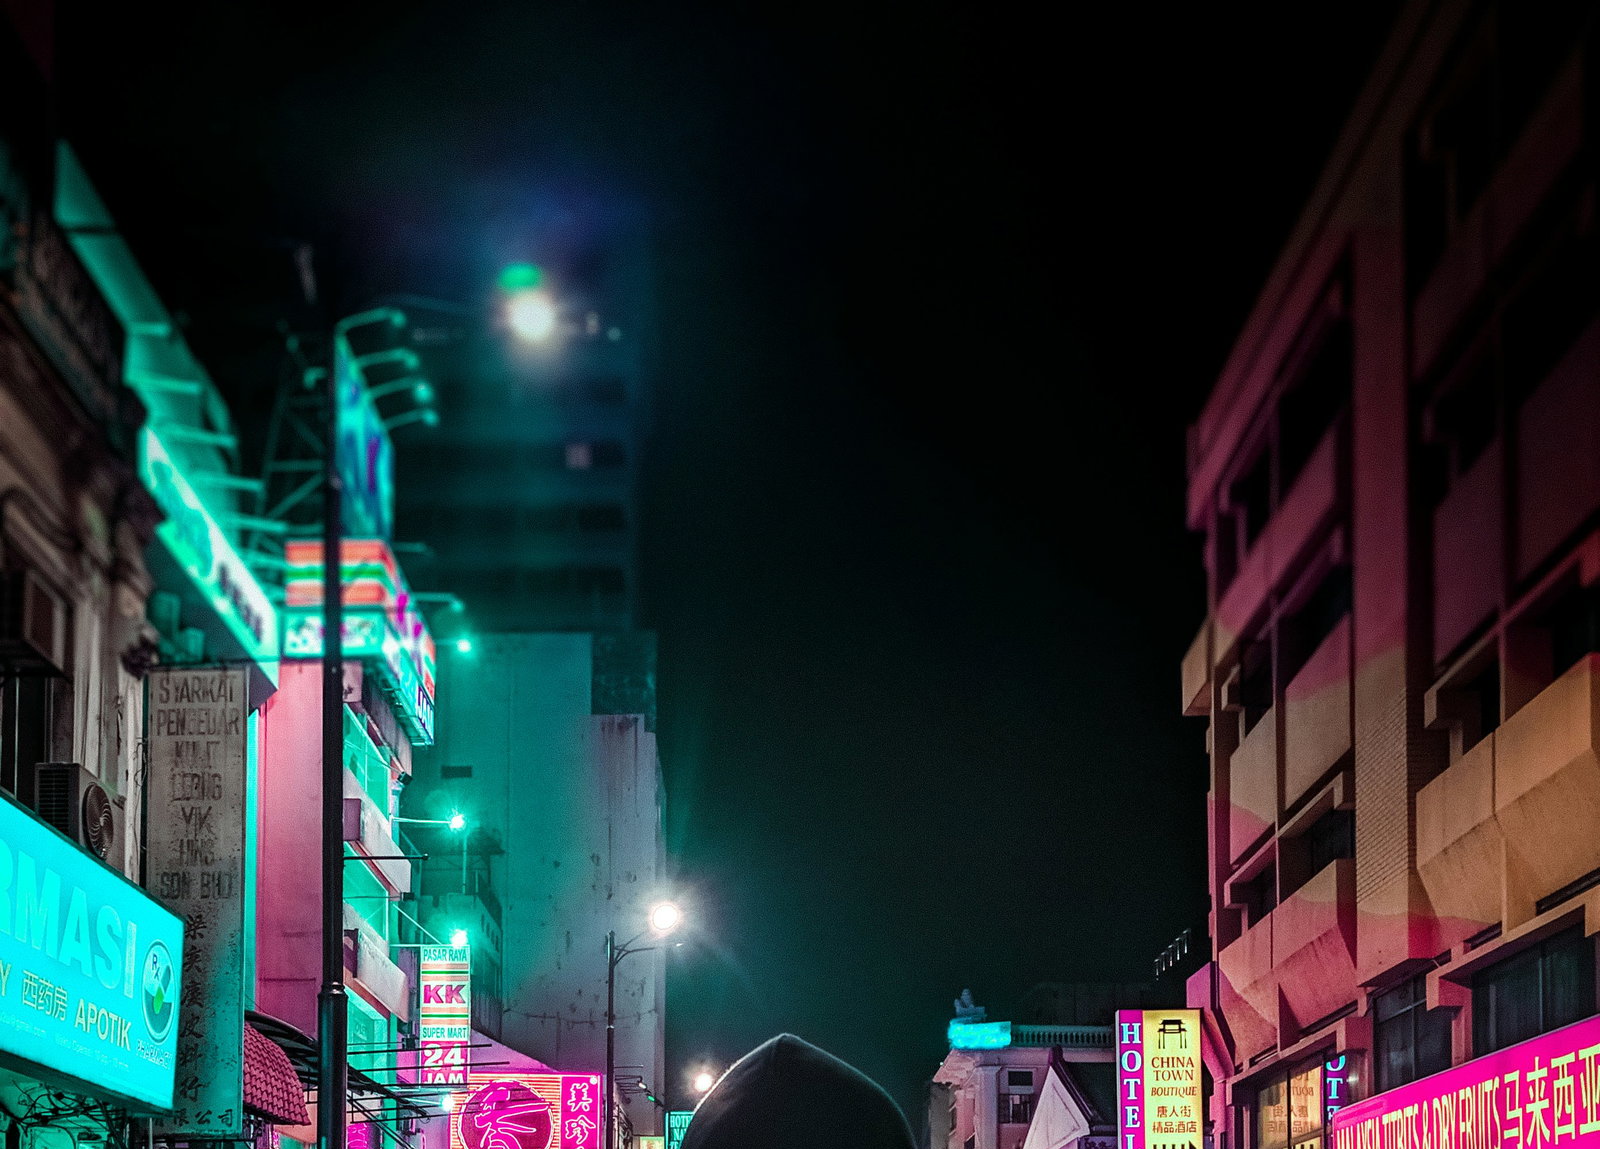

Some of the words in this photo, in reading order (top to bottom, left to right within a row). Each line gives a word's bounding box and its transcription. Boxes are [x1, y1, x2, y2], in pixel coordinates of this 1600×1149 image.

[424, 949, 446, 961] PASAR
[449, 948, 467, 961] RAYA
[423, 984, 466, 1004] KK
[22, 969, 68, 1022] 西药房
[74, 998, 131, 1052] APOTIK
[423, 1027, 445, 1038] SUPER
[448, 1027, 467, 1038] MART
[423, 1043, 465, 1070] 24
[1151, 1056, 1195, 1068] CHINA
[424, 1072, 464, 1084] JAM
[1153, 1069, 1194, 1081] TOWN
[1151, 1086, 1197, 1098] BOUTIQUE
[1157, 1105, 1191, 1118] 唐人街
[1152, 1121, 1197, 1133] 精品酒店
